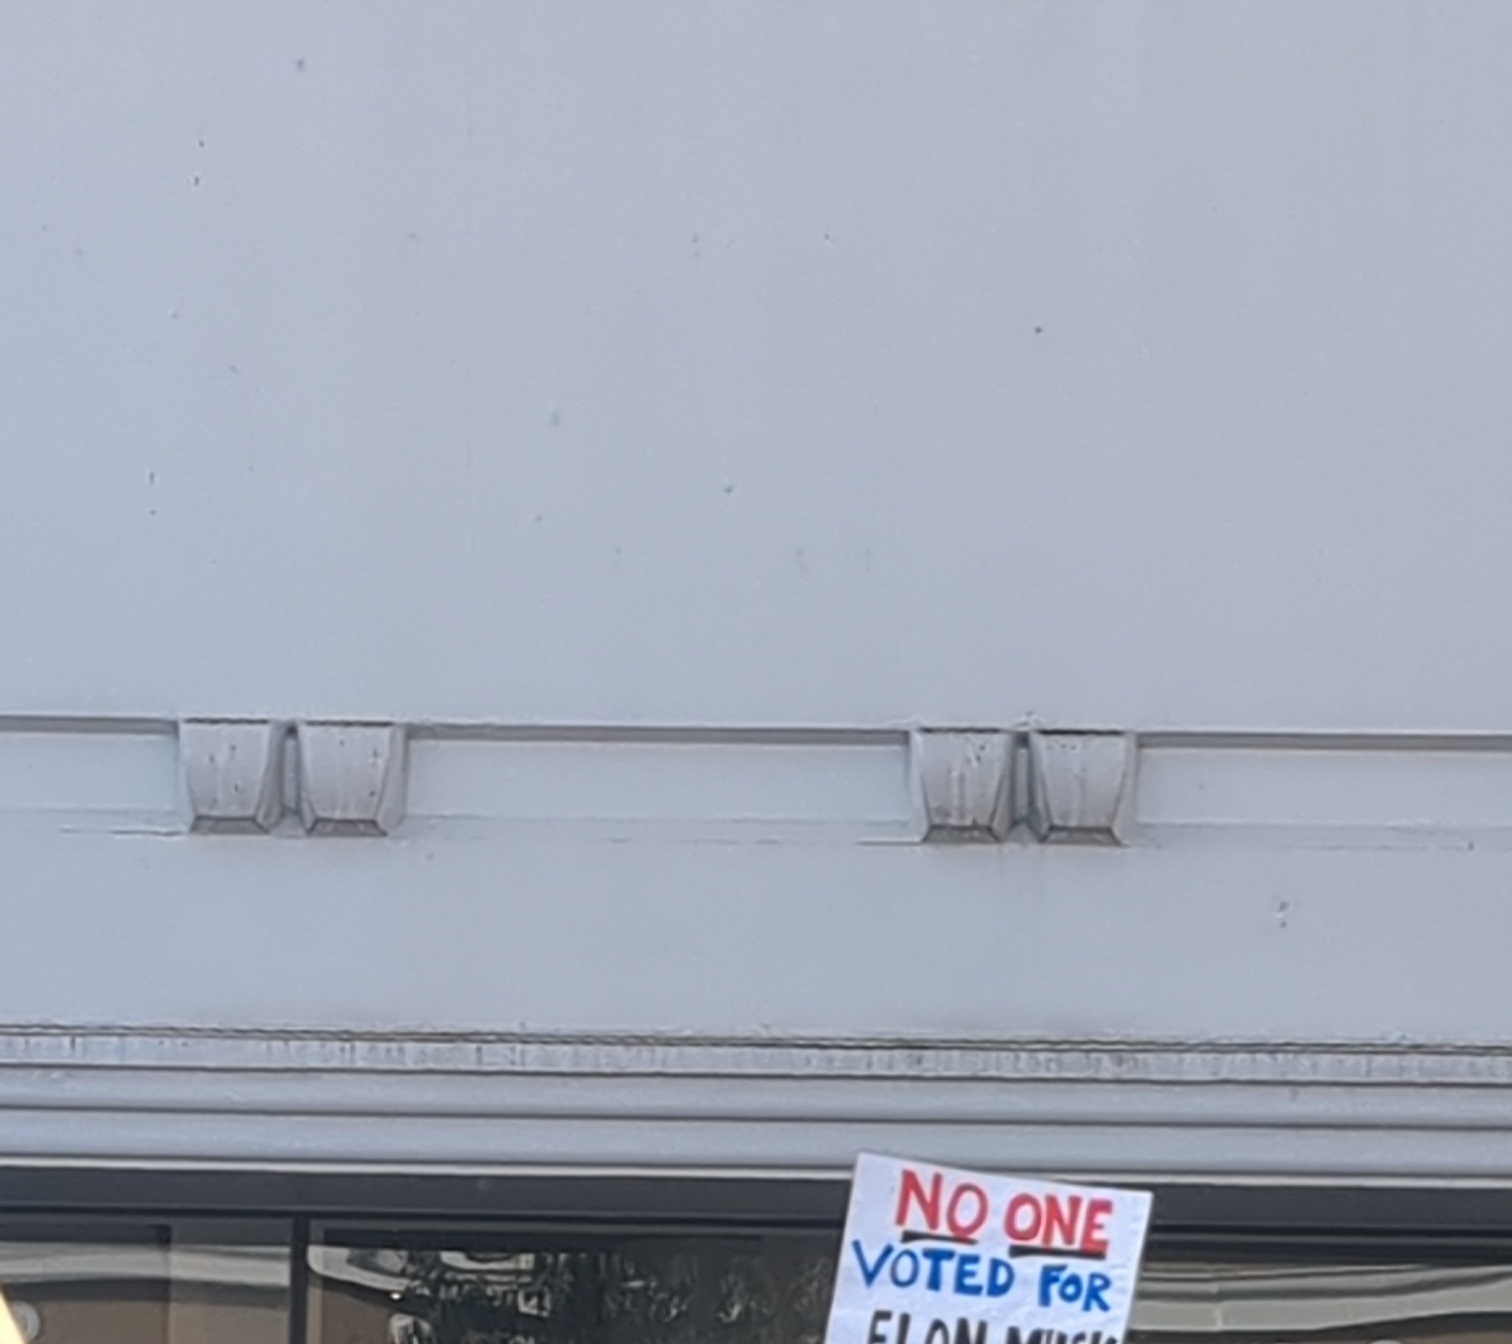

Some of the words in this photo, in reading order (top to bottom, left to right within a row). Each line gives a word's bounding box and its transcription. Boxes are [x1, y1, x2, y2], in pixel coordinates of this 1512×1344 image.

[894, 1168, 989, 1237] NO
[1003, 1193, 1114, 1253] ONE
[852, 1240, 1015, 1298] VOTED
[1038, 1264, 1112, 1312] FOR
